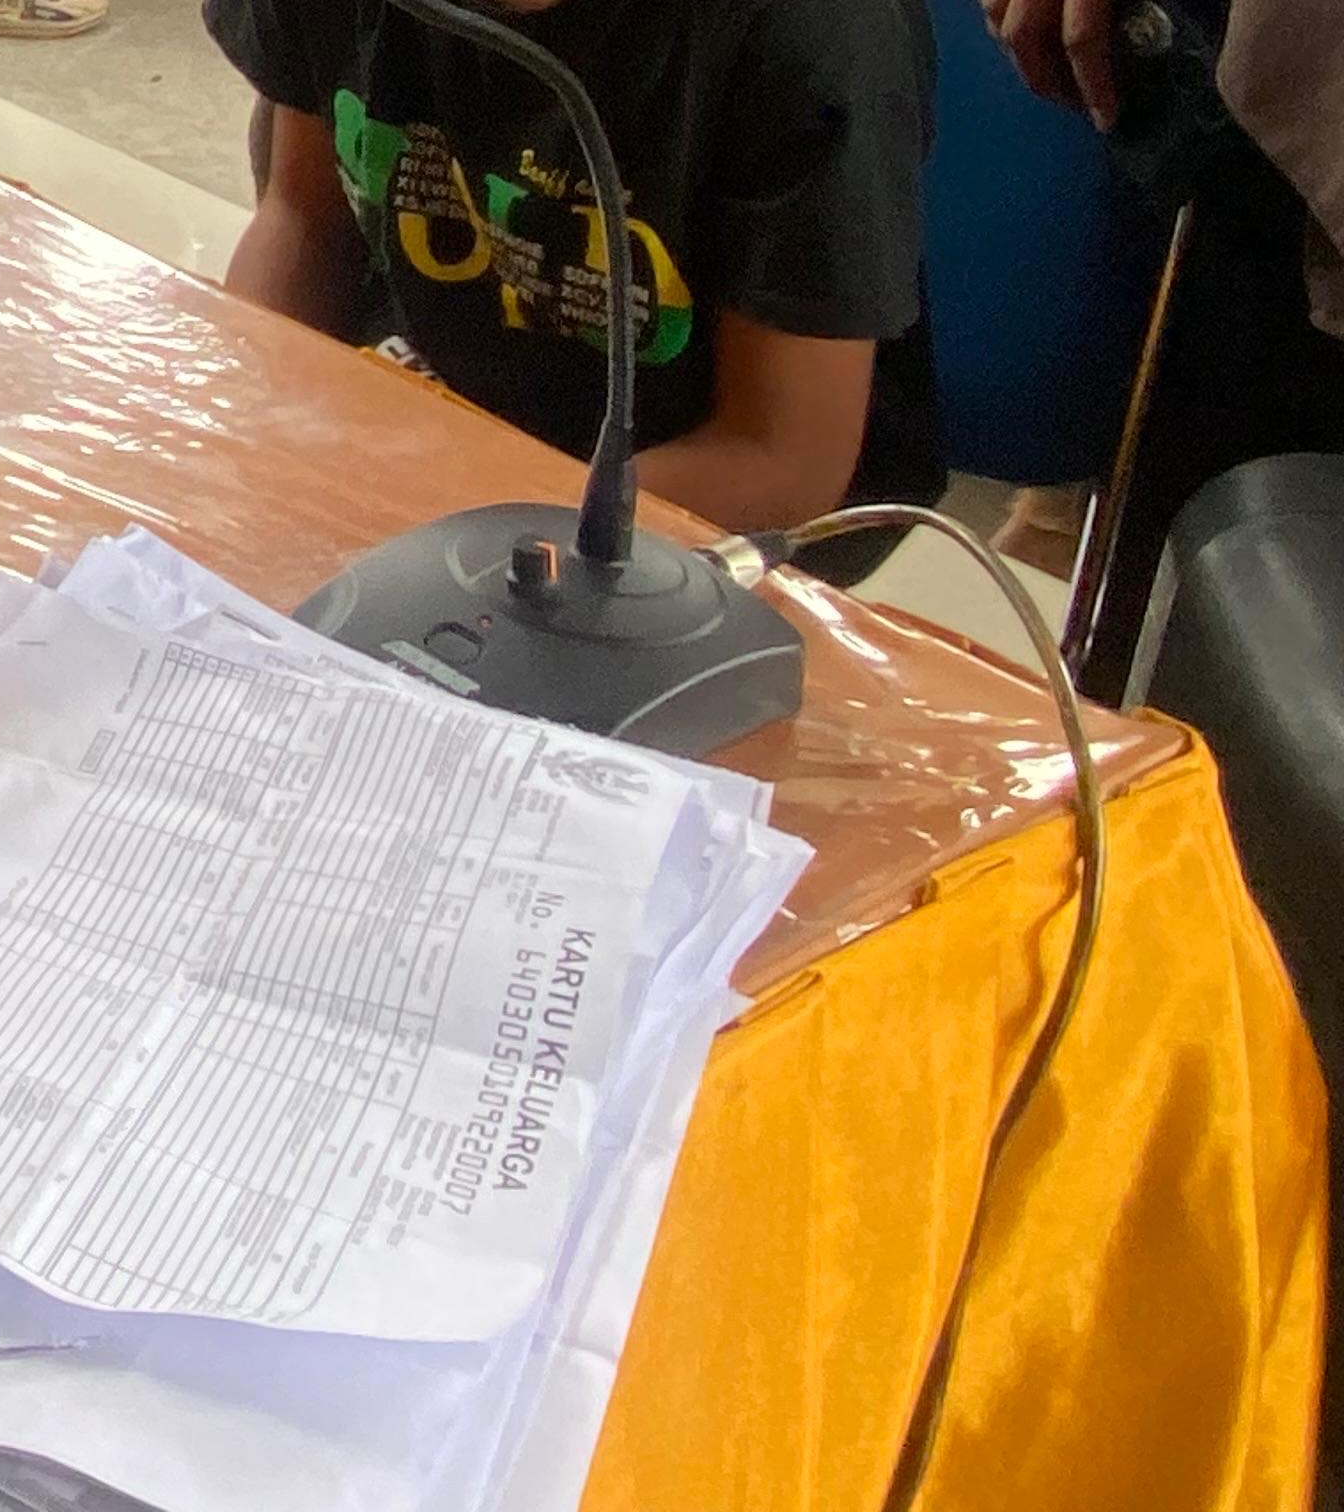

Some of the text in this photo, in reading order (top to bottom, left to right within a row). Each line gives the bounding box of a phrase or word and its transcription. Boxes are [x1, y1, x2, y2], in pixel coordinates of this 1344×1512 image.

[529, 890, 565, 929] No.
[439, 948, 547, 1216] 6403050109220007
[492, 927, 597, 1190] KARTU KELUARGA
